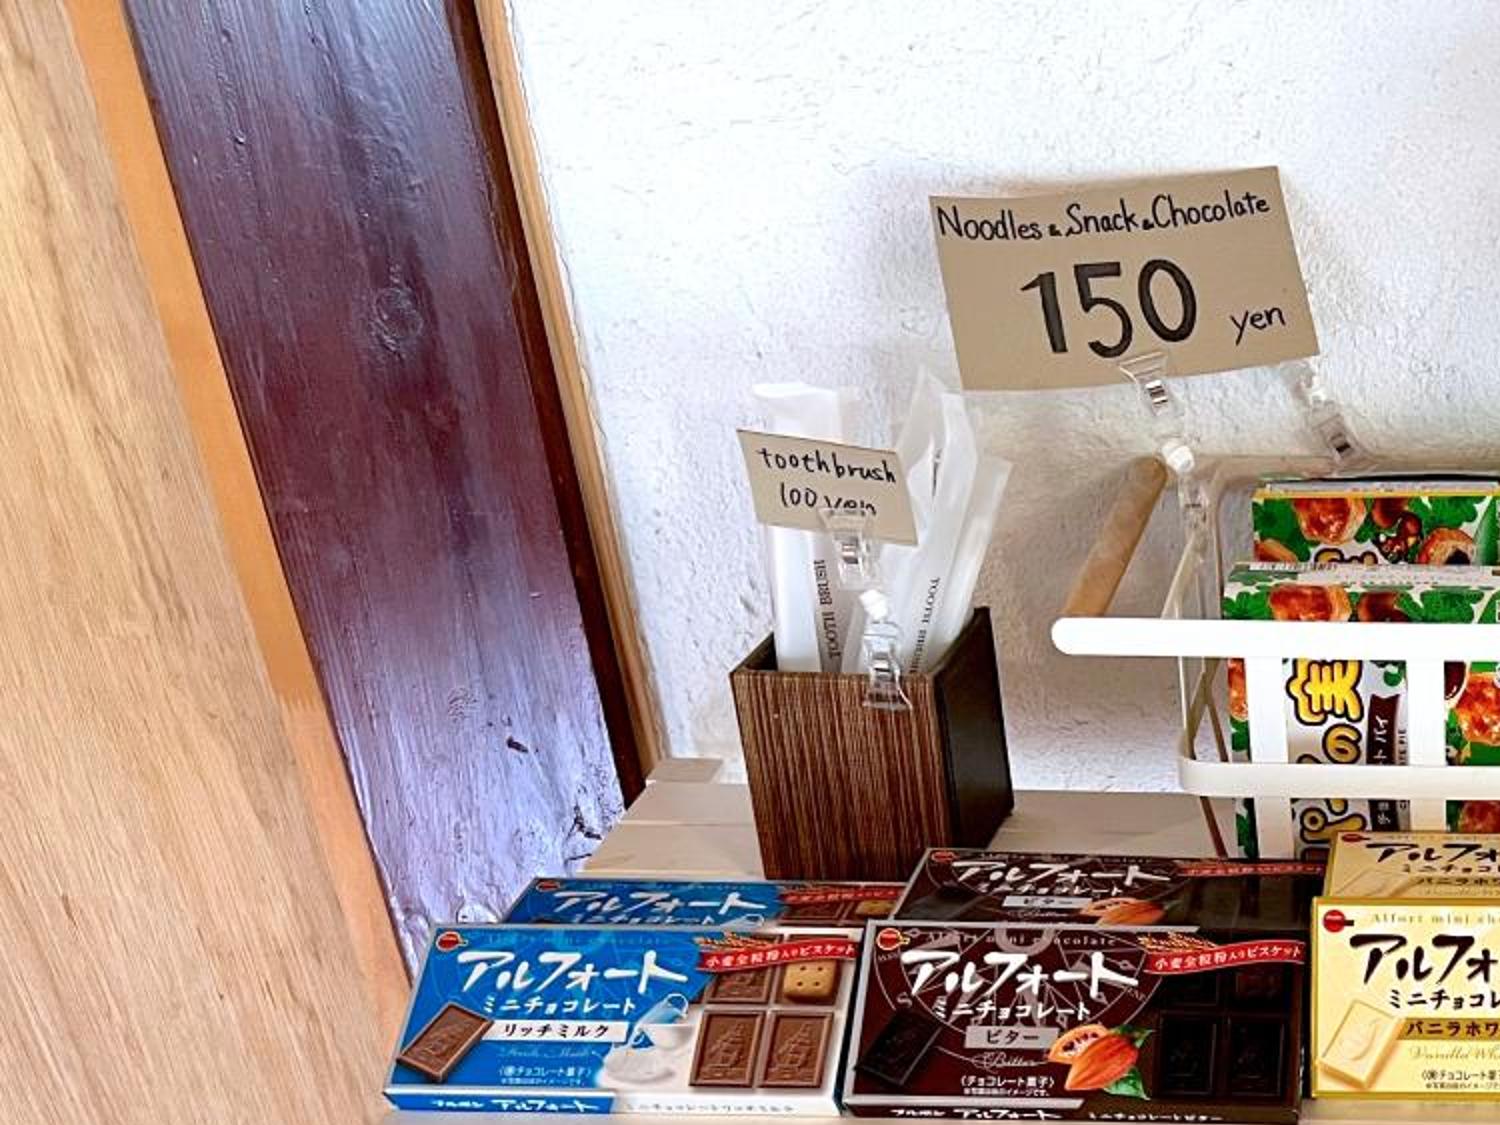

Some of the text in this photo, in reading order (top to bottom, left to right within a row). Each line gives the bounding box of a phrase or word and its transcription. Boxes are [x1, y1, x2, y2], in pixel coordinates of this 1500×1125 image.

[937, 206, 1042, 240] Noodles
[1066, 199, 1138, 237] Snack
[1152, 191, 1270, 228] Chocolate
[1020, 259, 1286, 358] 150 yen
[758, 448, 896, 484] toothbrush
[780, 483, 818, 508] 100
[952, 861, 1171, 885] アルフォート
[554, 891, 767, 917] アルフォート
[457, 949, 689, 994] アルフォート
[902, 951, 1139, 997] アルフォート
[484, 996, 637, 1015] ミニチョコレート
[935, 1002, 1091, 1020] ミニチョコレート
[504, 1023, 609, 1038] リッチミルク
[985, 1030, 1039, 1045] ビター
